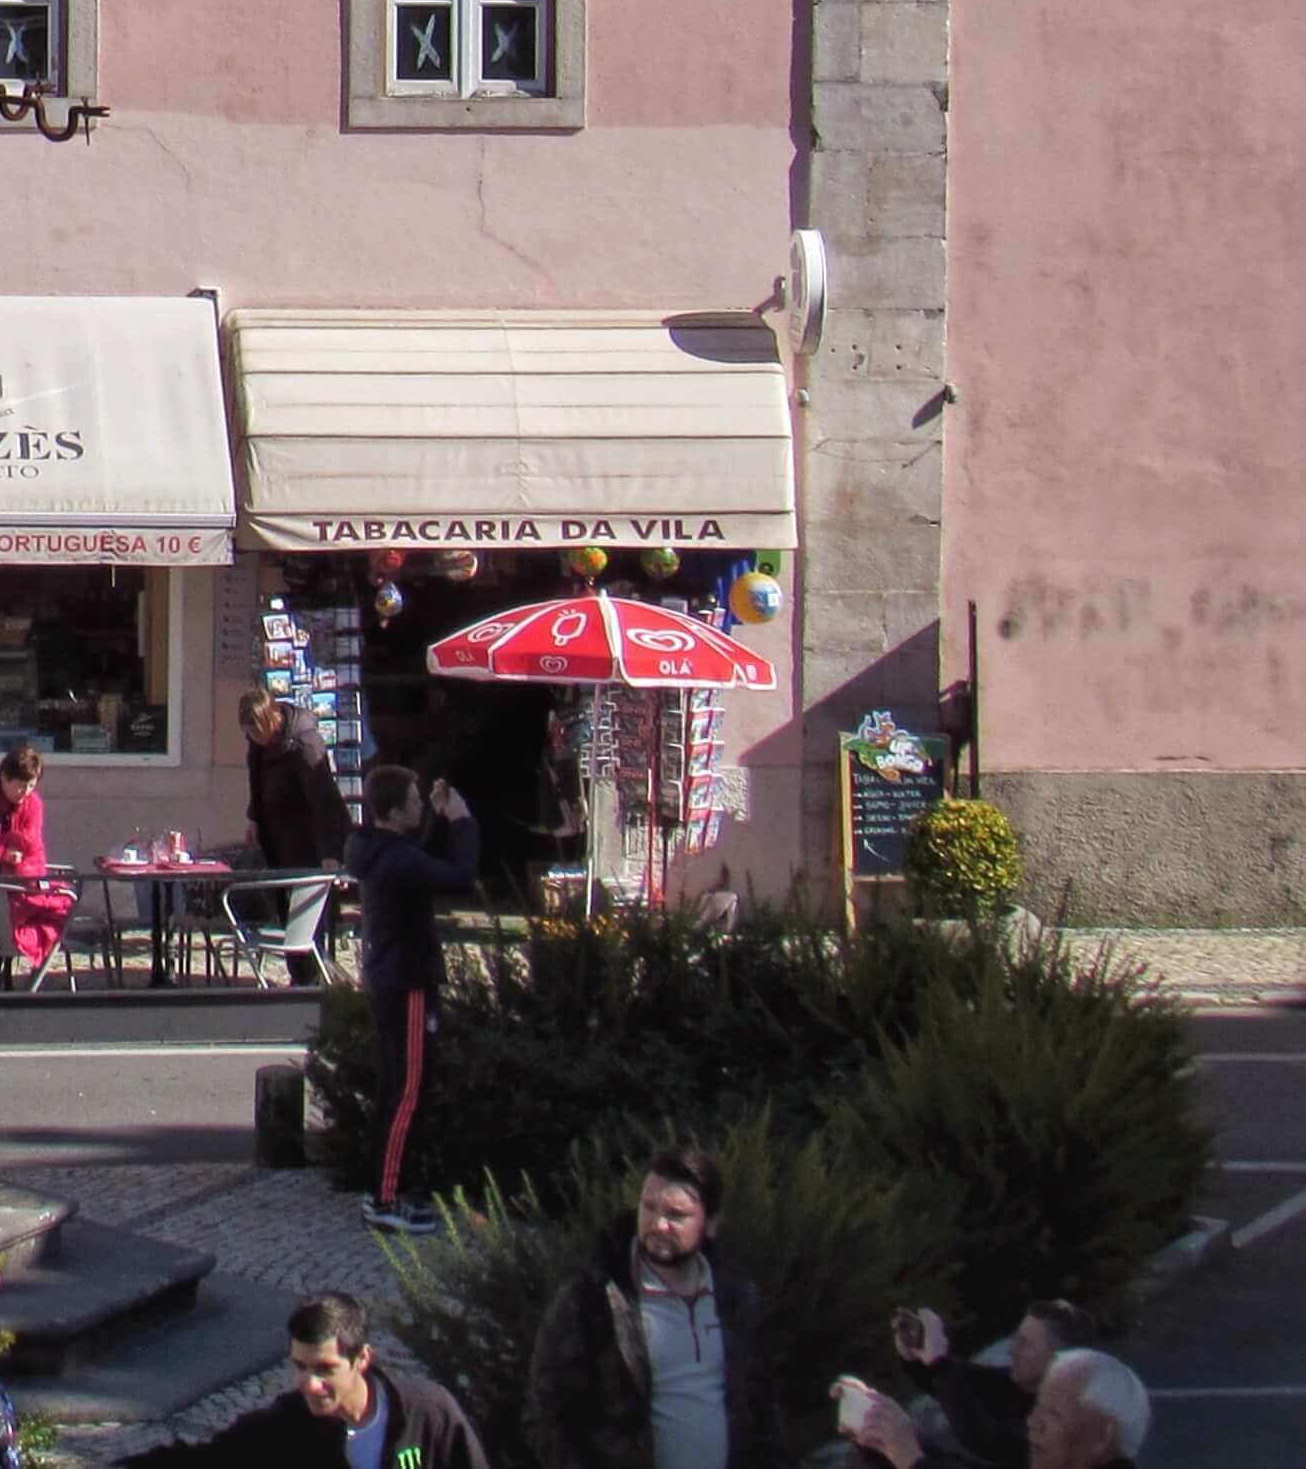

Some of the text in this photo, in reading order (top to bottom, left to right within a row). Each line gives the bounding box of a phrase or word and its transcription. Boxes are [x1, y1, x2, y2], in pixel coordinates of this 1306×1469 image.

[312, 518, 725, 541] TABACARIA DA VILA
[156, 536, 181, 553] 10
[187, 536, 202, 553] €
[658, 657, 692, 675] OLÁ
